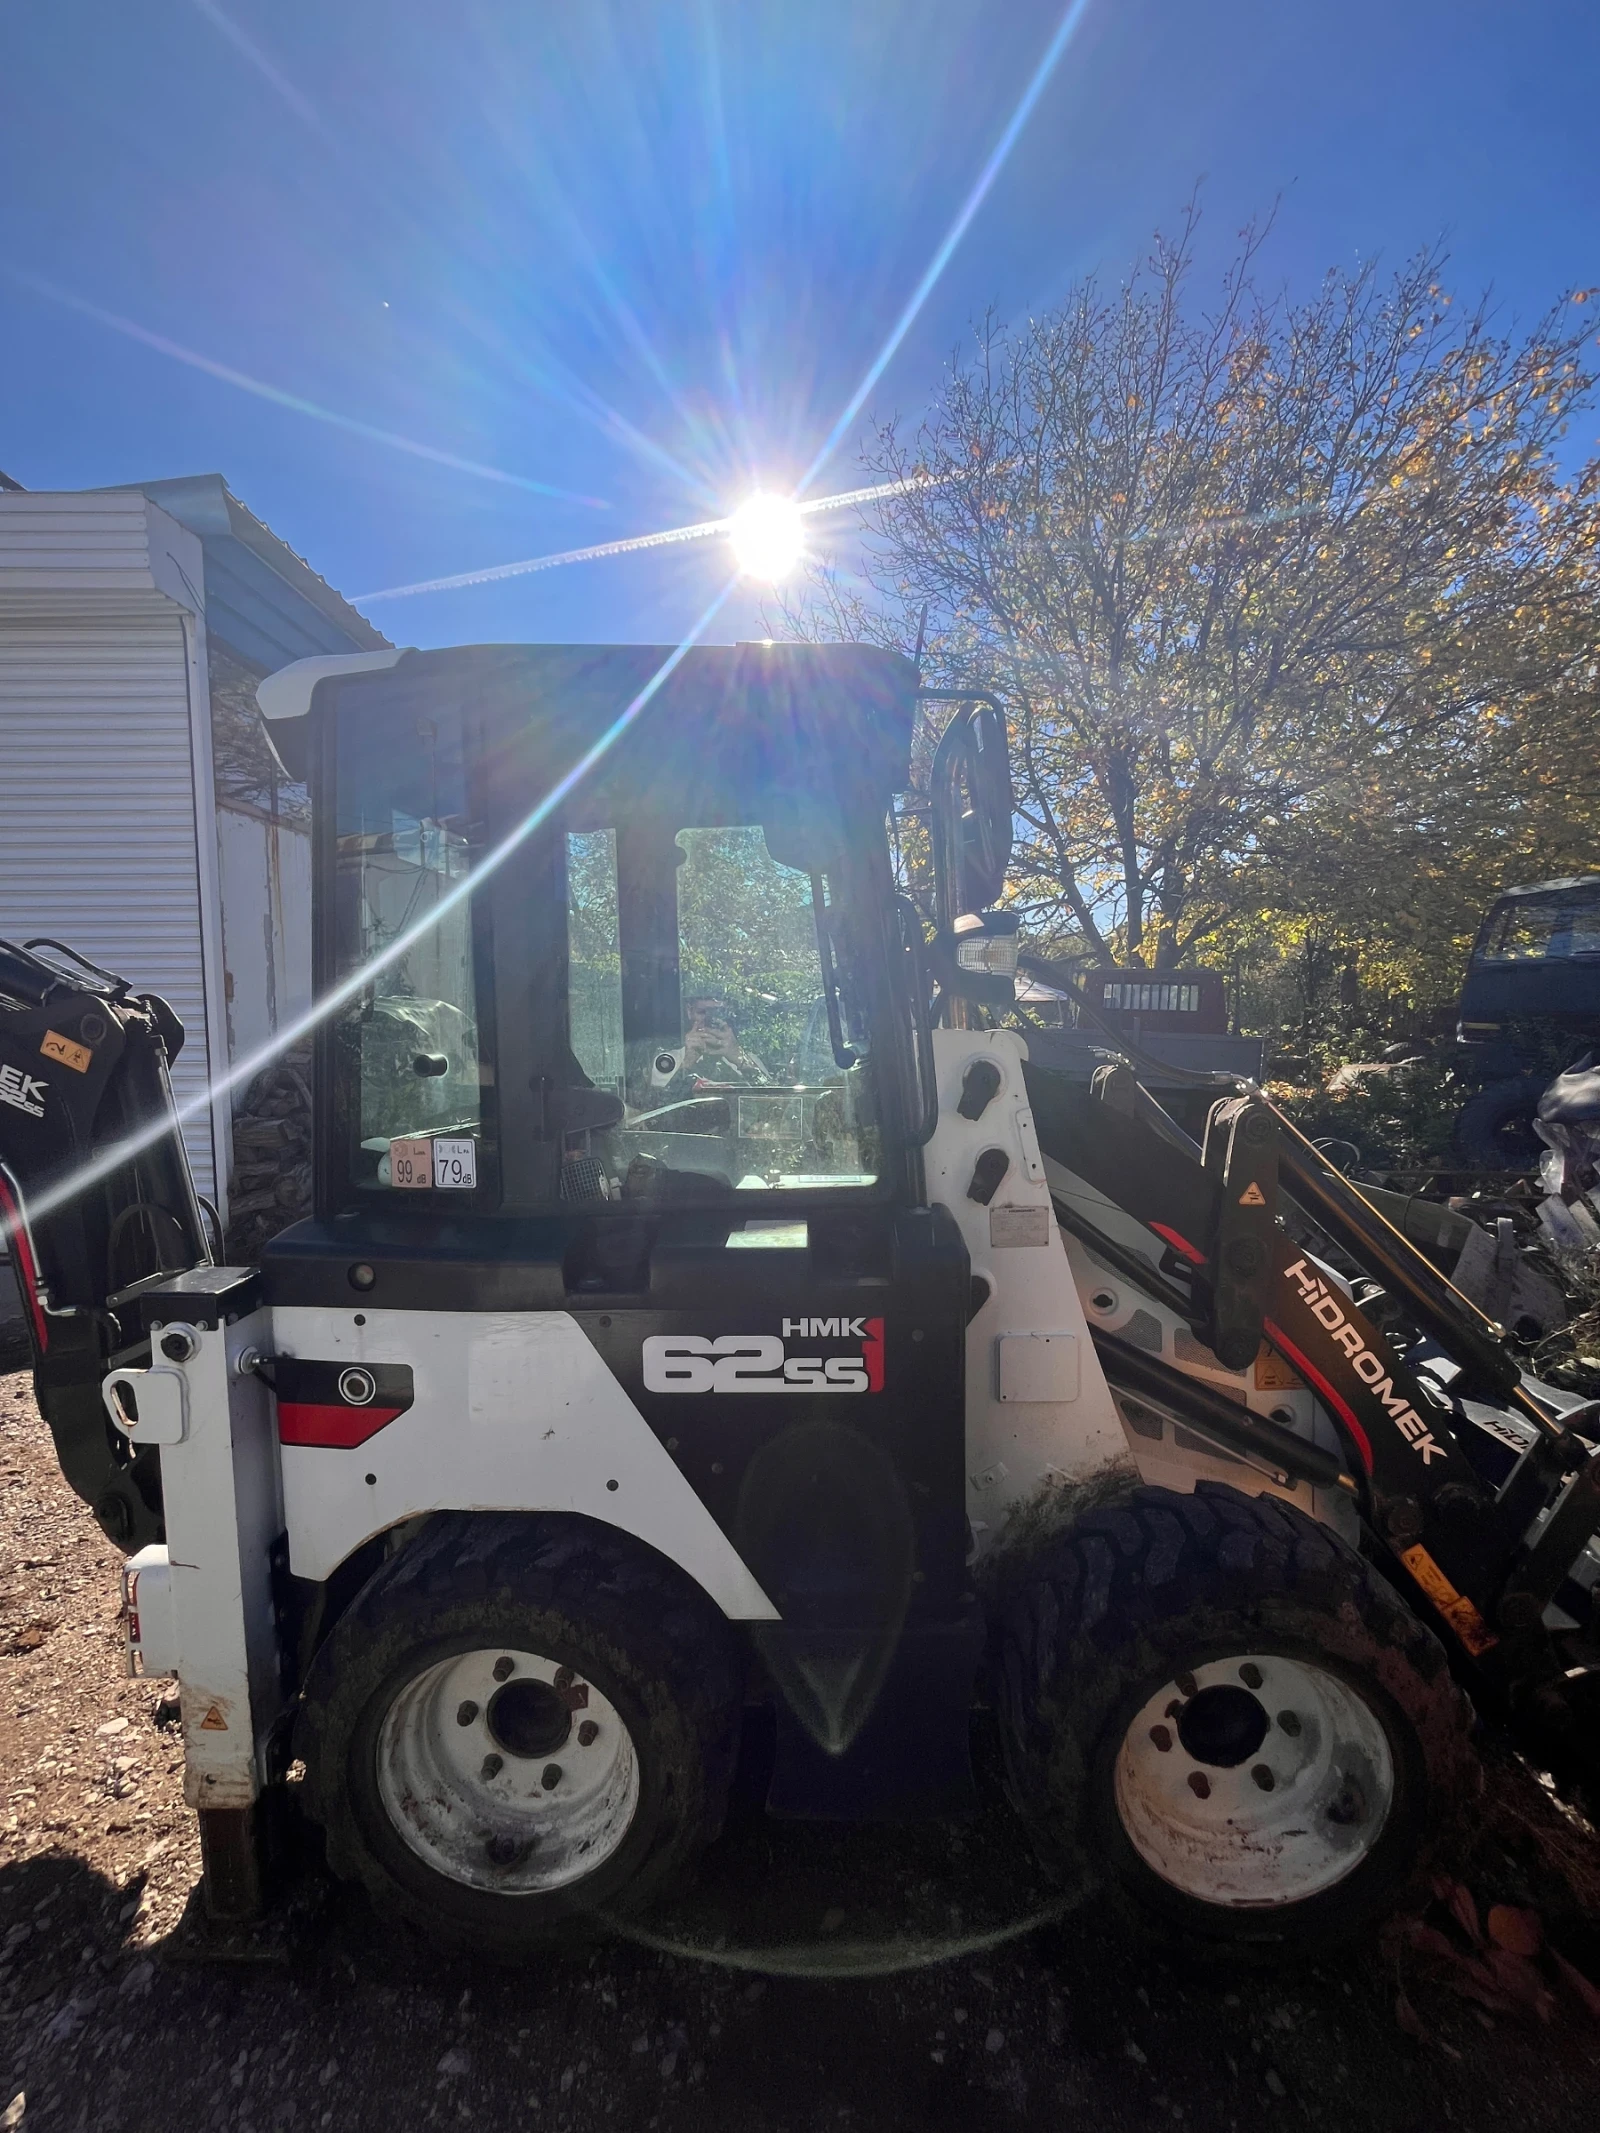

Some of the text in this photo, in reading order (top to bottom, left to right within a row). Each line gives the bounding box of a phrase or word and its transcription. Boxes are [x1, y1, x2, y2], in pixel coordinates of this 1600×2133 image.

[397, 1159, 427, 1184] 99 dB
[439, 1159, 472, 1184] 79 dB
[782, 1317, 868, 1338] HMK
